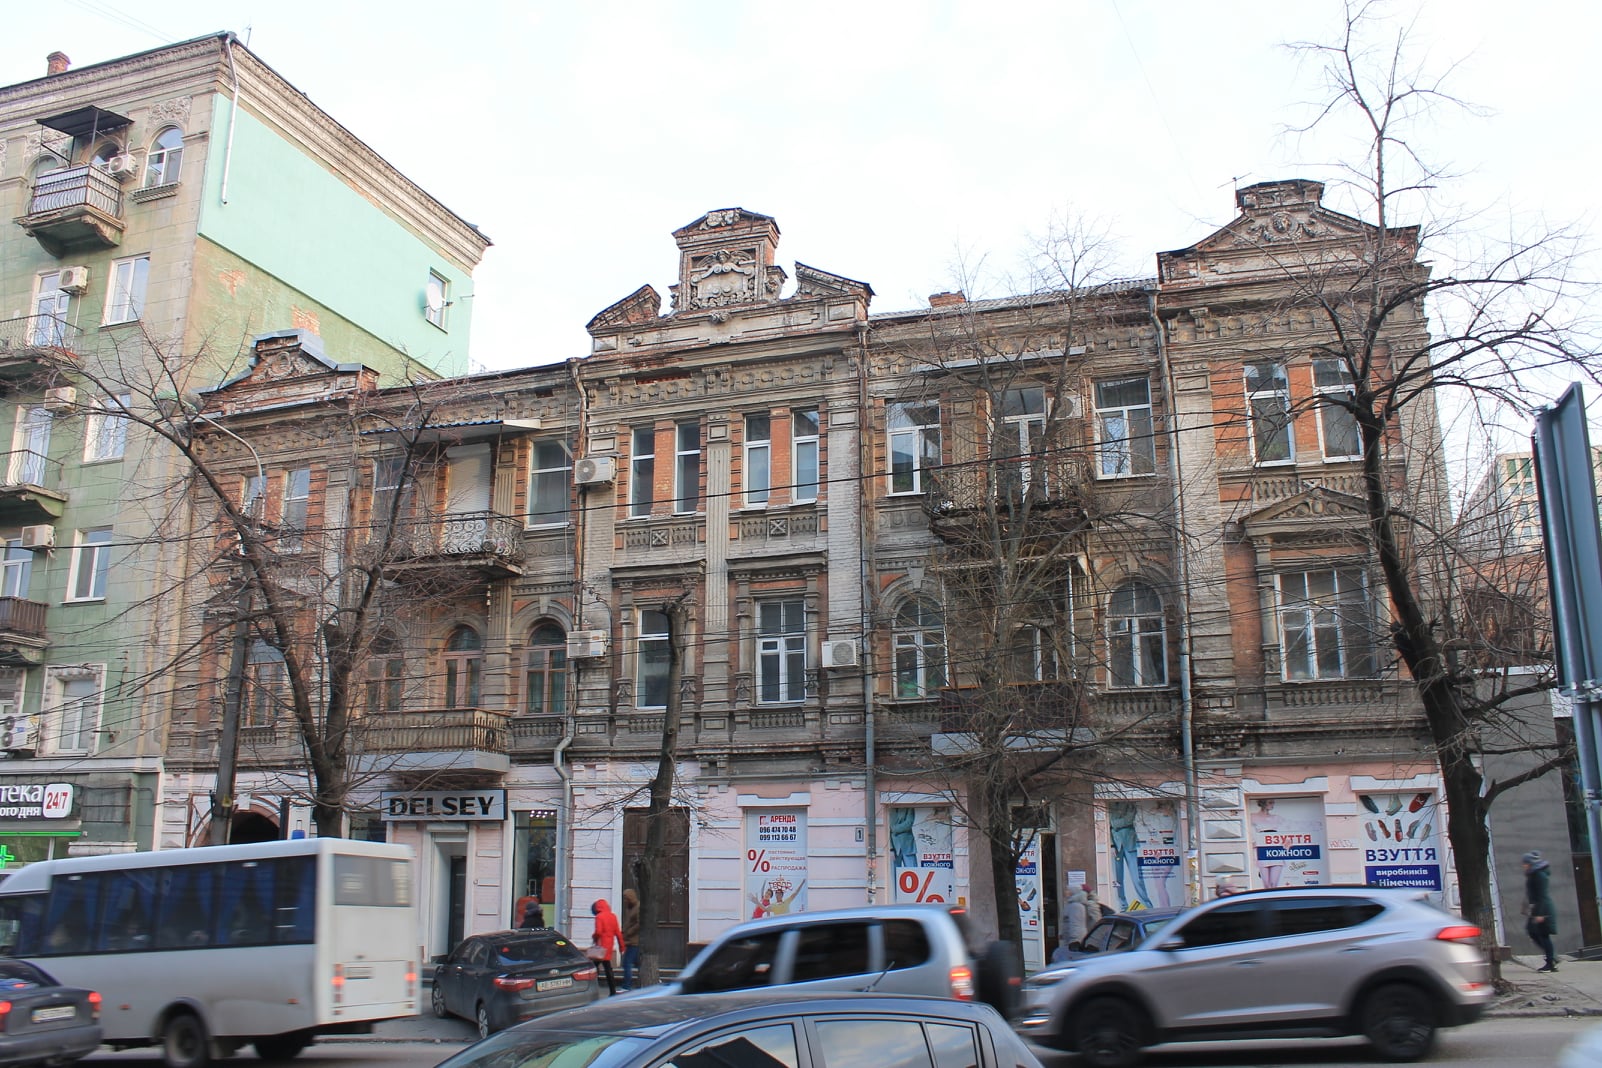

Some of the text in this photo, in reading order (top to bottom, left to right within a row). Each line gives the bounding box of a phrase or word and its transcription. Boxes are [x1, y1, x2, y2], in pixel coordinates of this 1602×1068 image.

[46, 792, 69, 810] 24/7
[389, 796, 494, 816] DELSEY
[18, 807, 41, 818] дня
[770, 815, 796, 823] АРЕНДА
[1265, 834, 1311, 844] ВЗУТТЯ
[1143, 848, 1175, 856] ВЗУТТЯ
[1266, 849, 1312, 857] КОЖНОГО
[1365, 847, 1437, 862] ВЗУТТЯ
[1376, 868, 1428, 877] виробників
